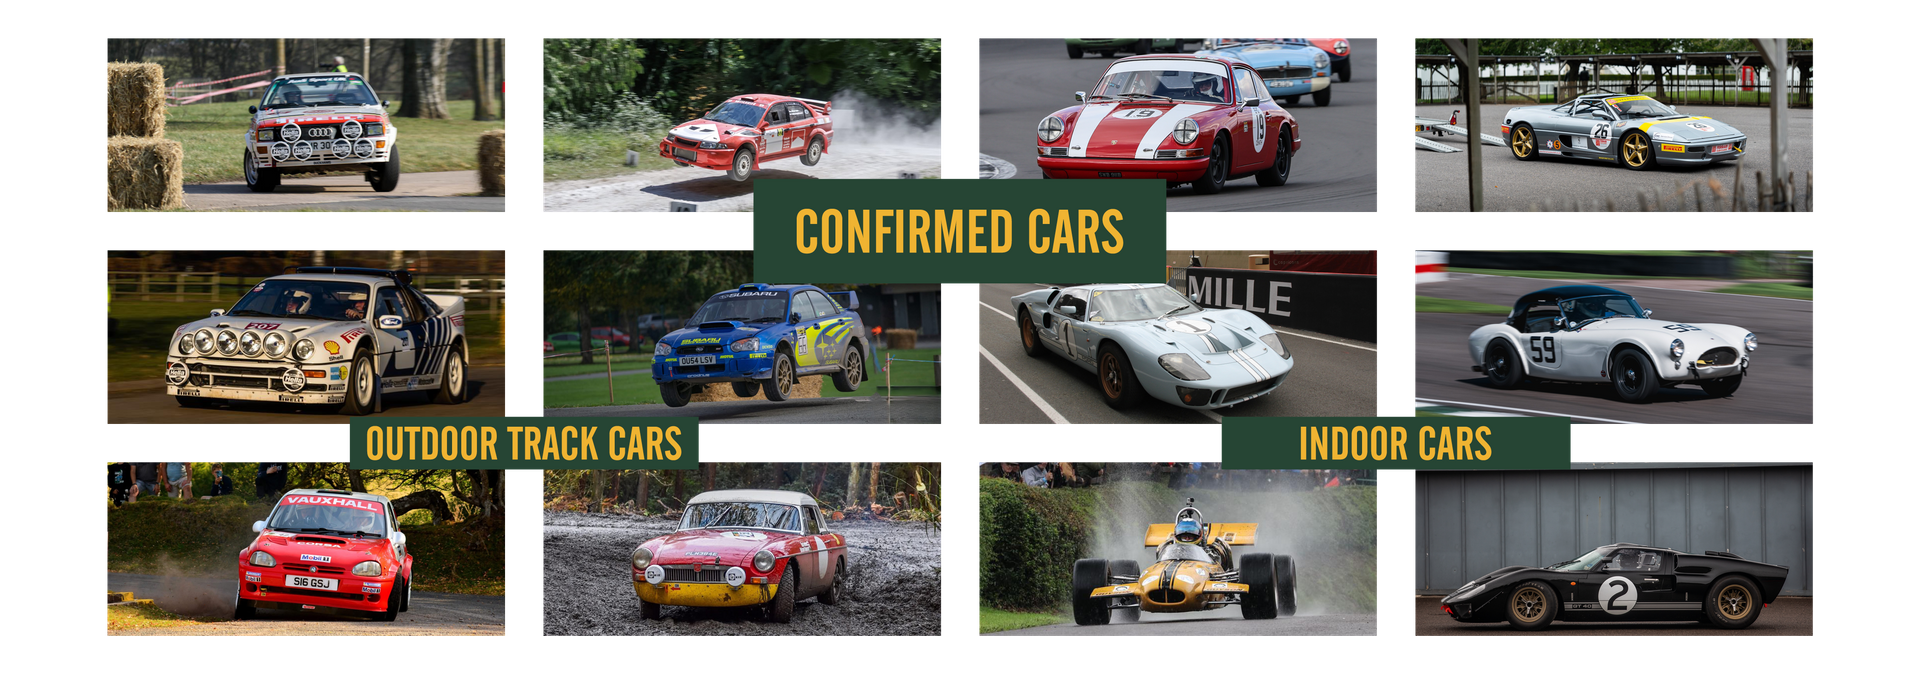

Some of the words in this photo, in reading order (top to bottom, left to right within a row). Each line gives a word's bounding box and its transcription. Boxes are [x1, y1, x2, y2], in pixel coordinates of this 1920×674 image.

[1255, 115, 1265, 140] 19
[1594, 123, 1610, 139] 26
[1188, 275, 1293, 317] MILLE
[247, 323, 279, 331] 207
[1175, 320, 1208, 333] 1
[681, 337, 722, 345] SUBARU
[1062, 322, 1075, 358] 1
[1529, 336, 1556, 363] 59
[700, 356, 714, 364] LSV
[285, 376, 303, 384] Hella
[177, 388, 201, 396] PIRELLI
[279, 394, 304, 403] PIRELLI
[287, 496, 379, 512] VAUXHALL
[293, 577, 309, 587] S16
[310, 578, 330, 588] GSJ
[1606, 579, 1630, 611] 2
